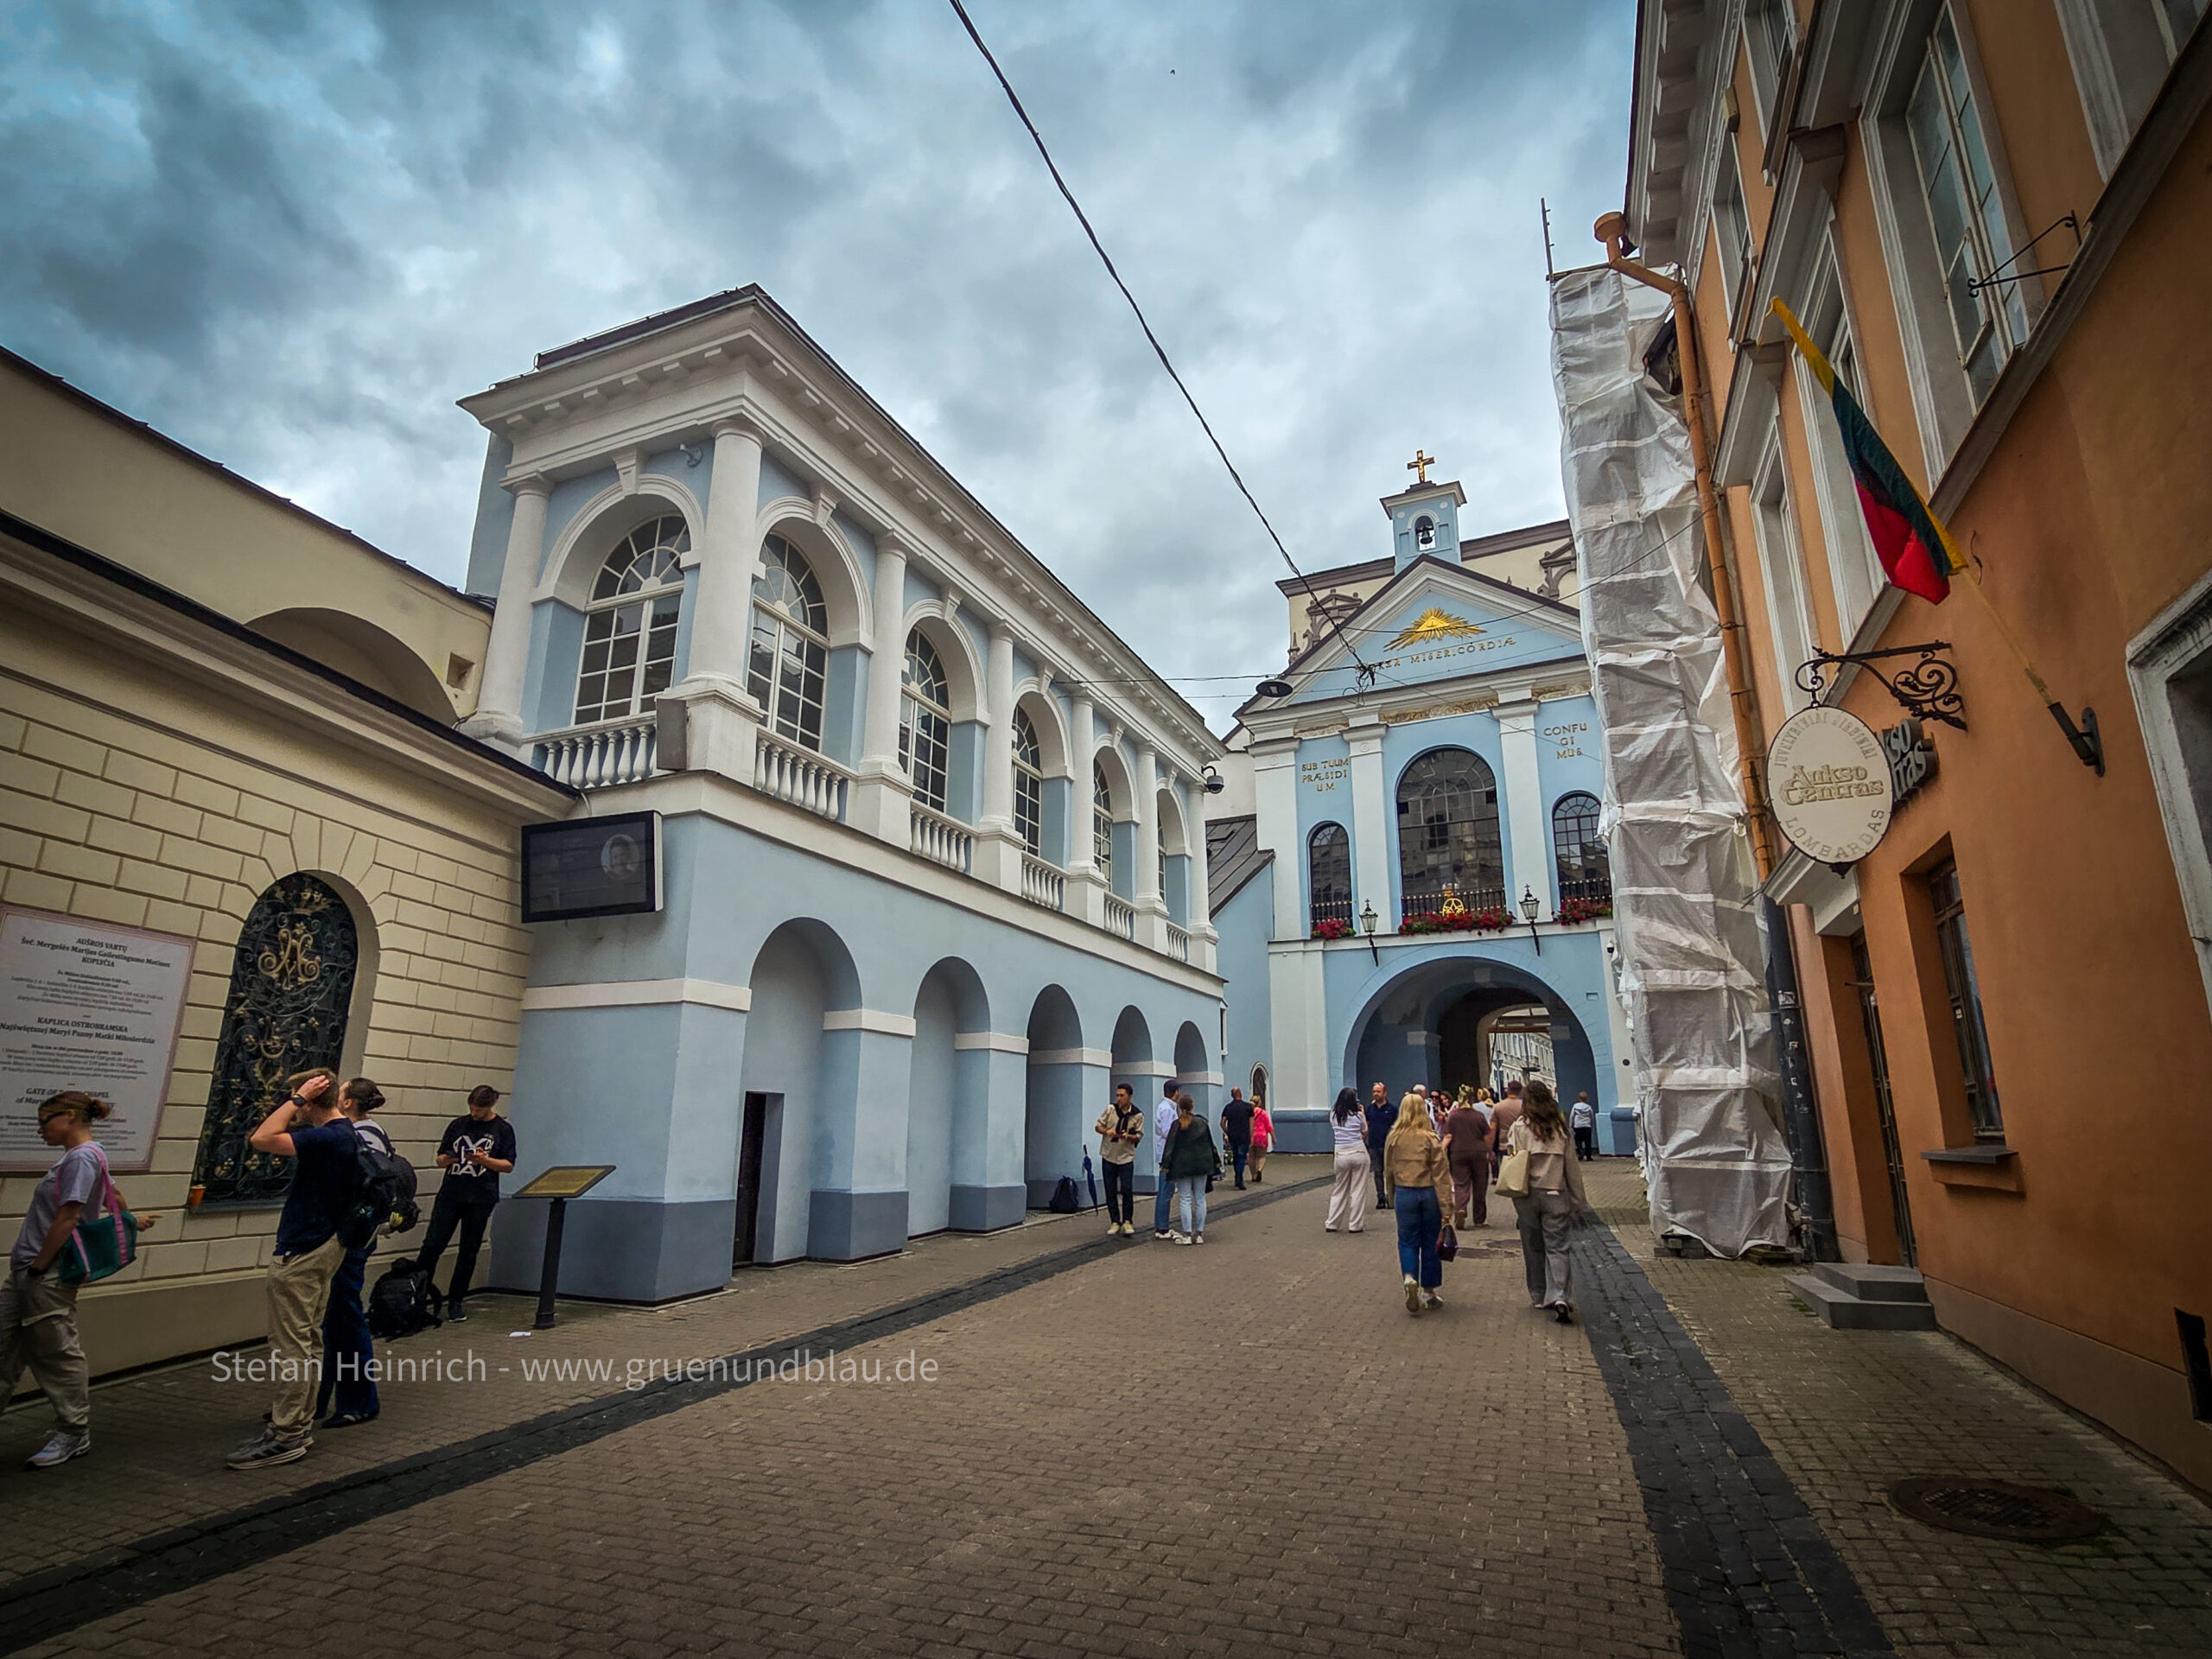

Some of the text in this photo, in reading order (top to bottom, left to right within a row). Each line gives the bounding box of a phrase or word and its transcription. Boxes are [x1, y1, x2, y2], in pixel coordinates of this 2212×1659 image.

[1543, 722, 1587, 736] CONFU
[1560, 736, 1574, 746] GI
[1556, 747, 1583, 760] MUS
[1301, 758, 1349, 772] SUB TUUM
[1791, 764, 1868, 785] Aukso
[1779, 779, 1885, 806] Centras
[1785, 809, 1885, 859] LOMBARDAS
[37, 1017, 70, 1027] KAPLICA
